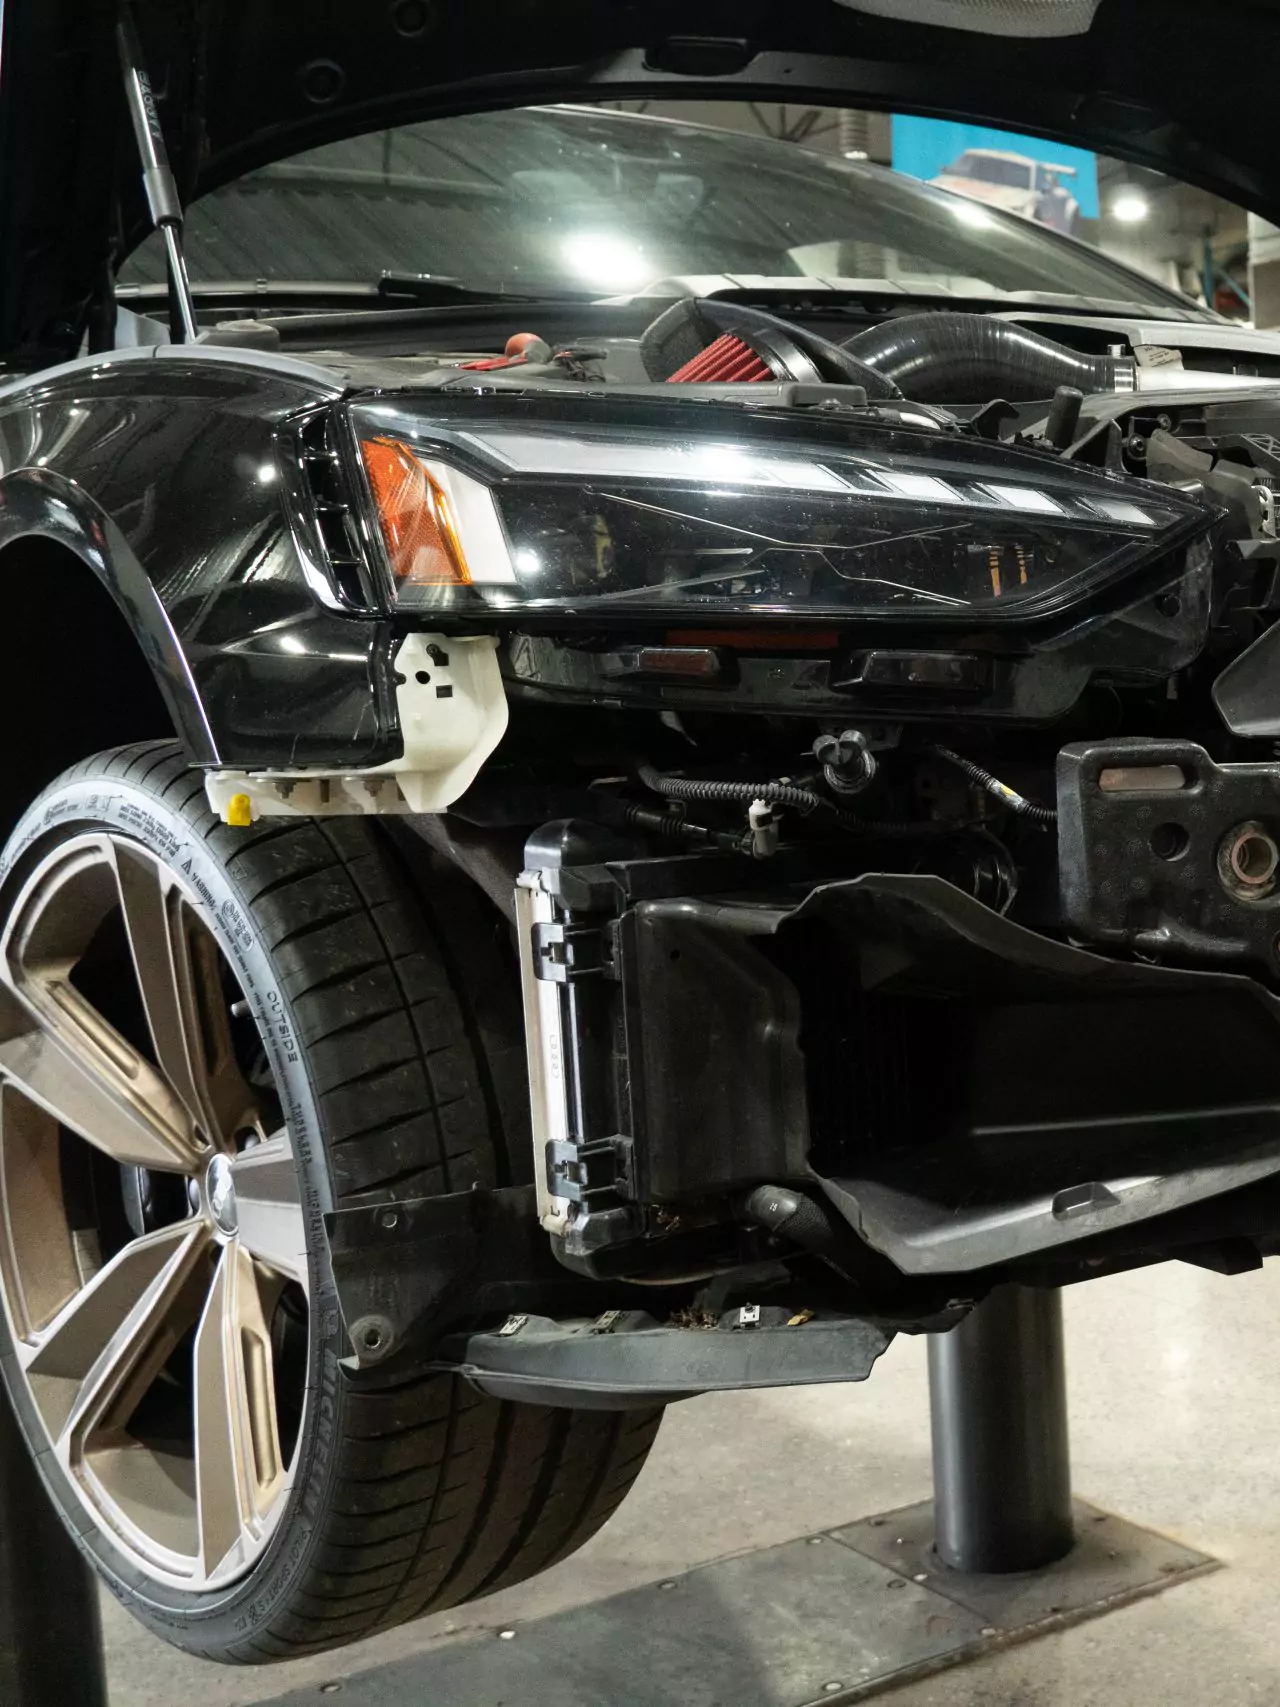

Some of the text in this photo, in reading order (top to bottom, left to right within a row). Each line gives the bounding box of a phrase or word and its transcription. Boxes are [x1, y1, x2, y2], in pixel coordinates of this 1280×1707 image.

[267, 991, 299, 1062] OUTSIDE
[304, 1348, 337, 1516] MICHELIN
[267, 1563, 291, 1601] SPORT
